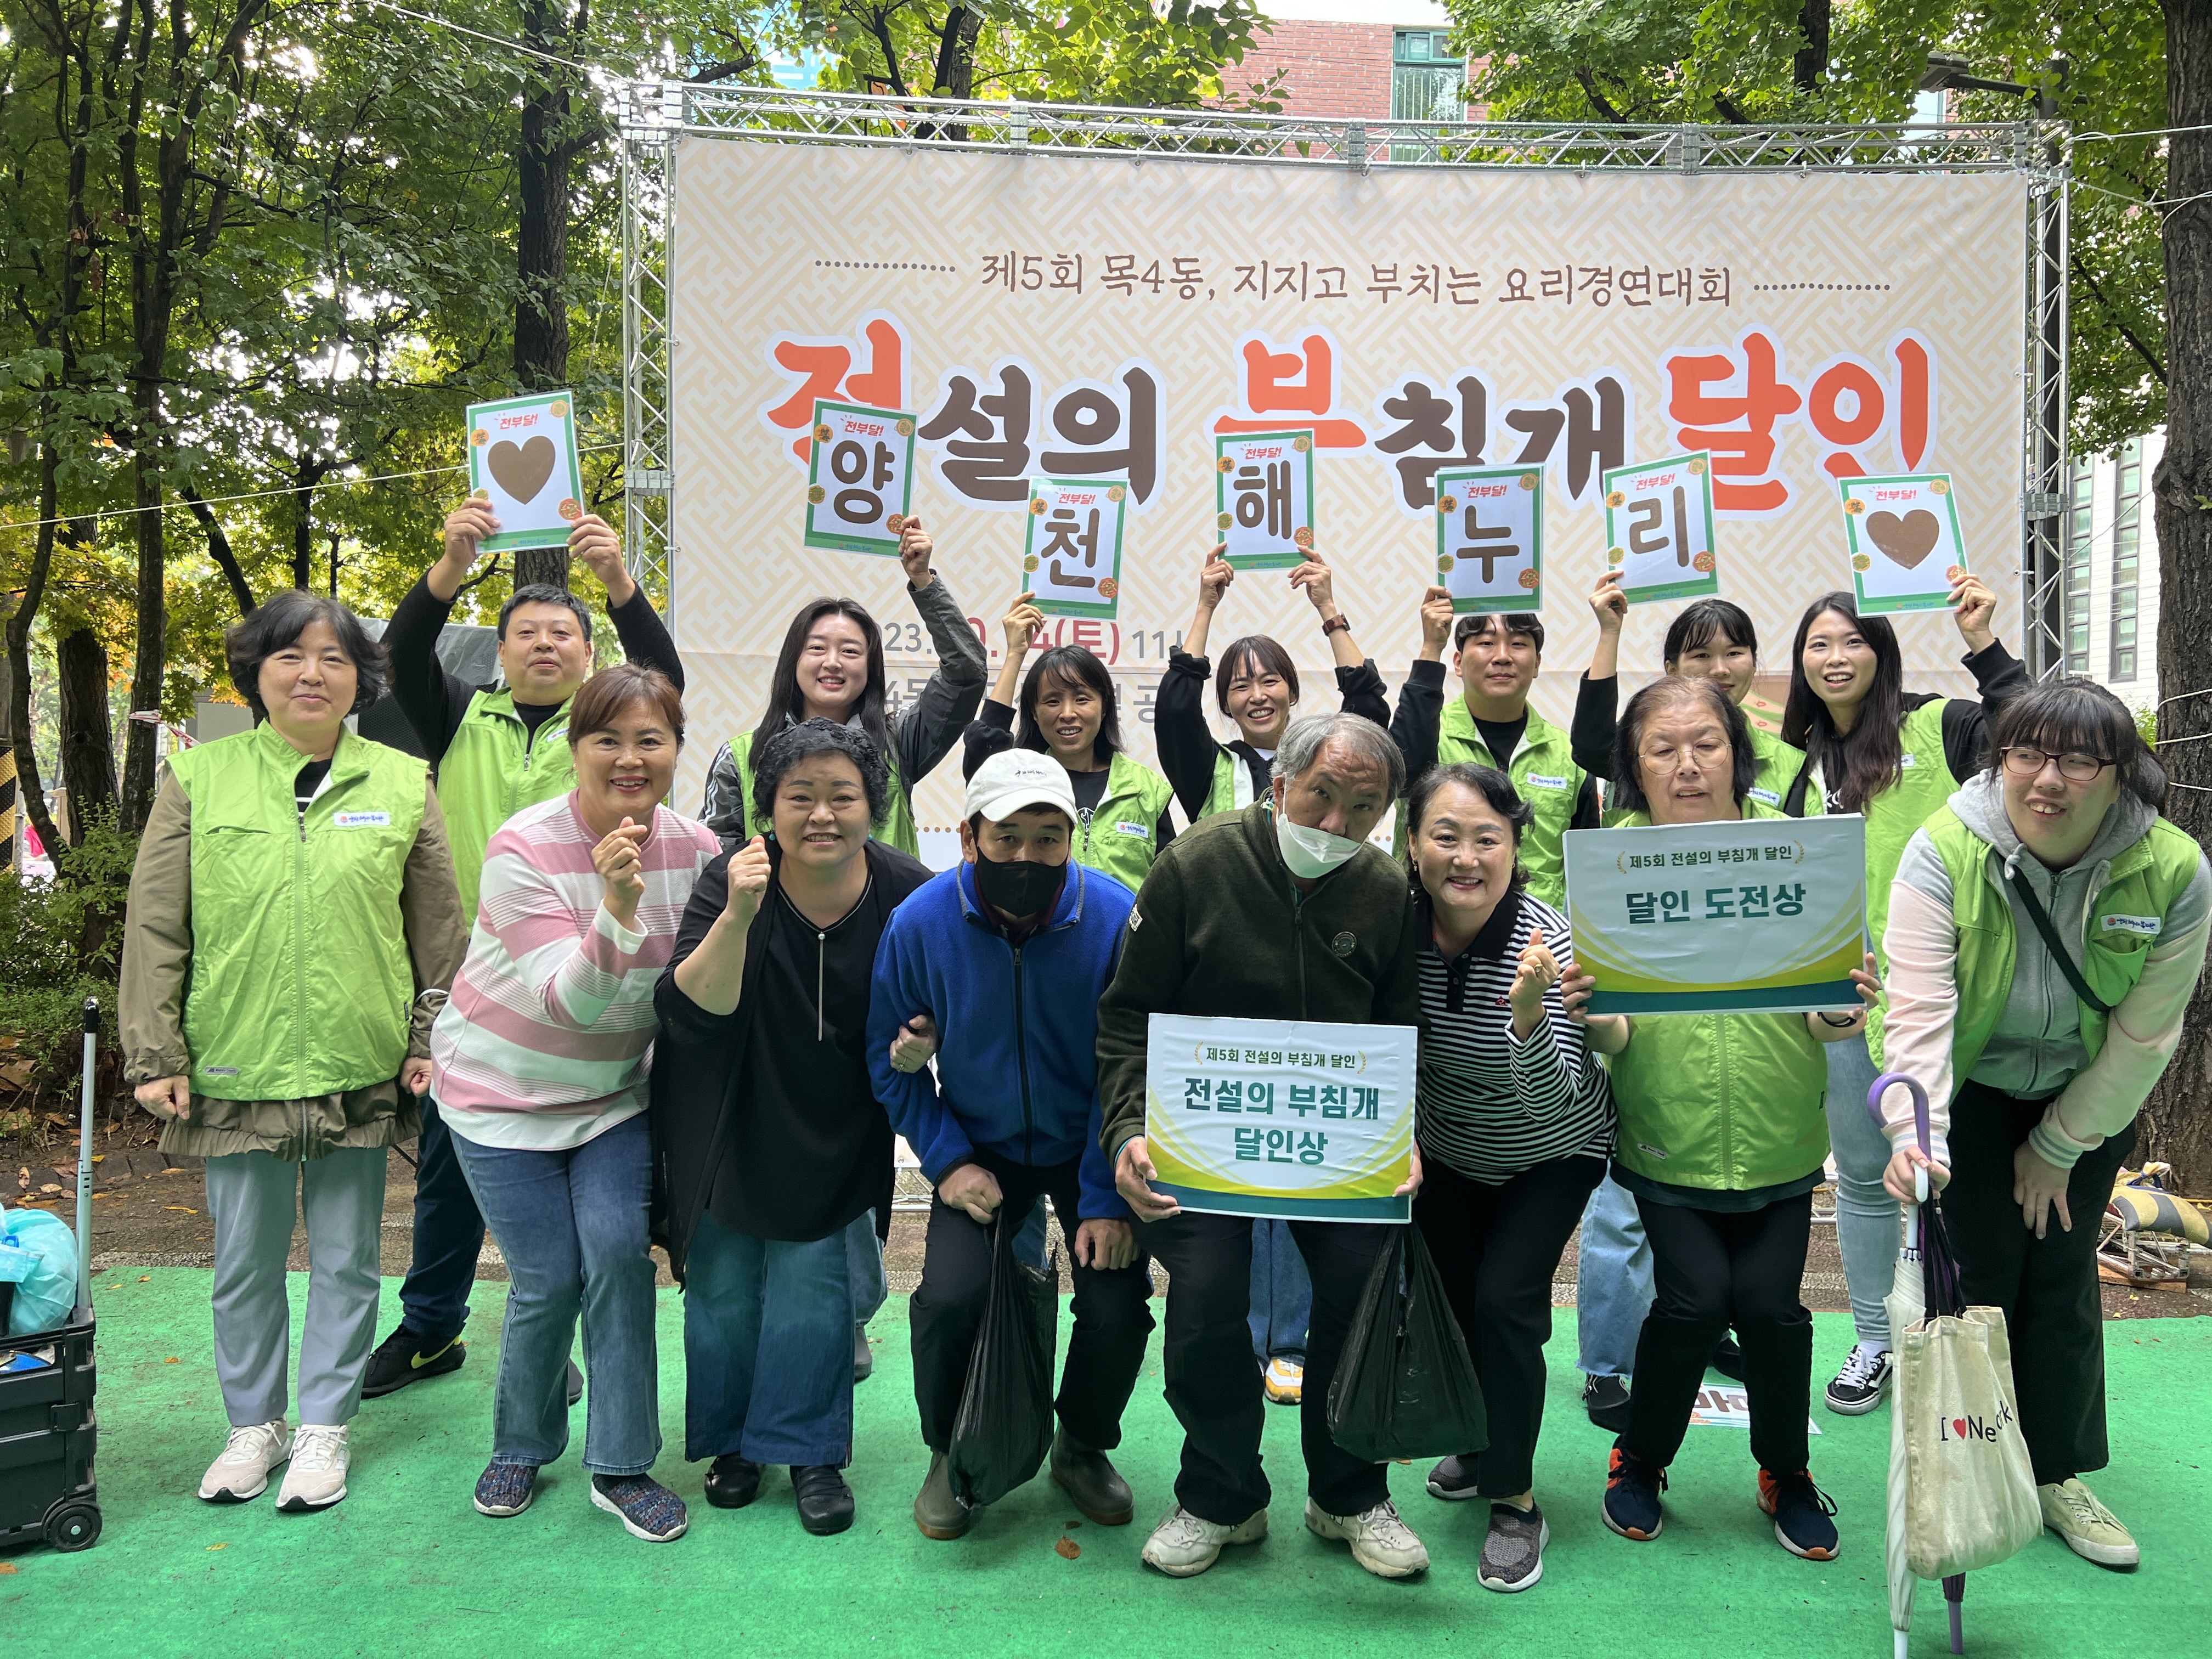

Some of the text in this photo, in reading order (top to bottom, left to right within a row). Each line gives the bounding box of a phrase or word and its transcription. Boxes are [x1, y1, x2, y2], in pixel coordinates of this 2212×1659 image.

[982, 250, 1730, 307] 제5회 목4동, 지지고 부치는 요리경연대회
[500, 413, 538, 430] 전부달!
[768, 319, 1928, 511] 전설의 부침개 달인
[844, 421, 884, 437] 전부달!
[1245, 447, 1282, 460] 전부달!
[831, 440, 895, 524] 양
[1058, 493, 1096, 505] 전부달!
[1233, 460, 1292, 540] 해
[1468, 485, 1508, 499] 전부달!
[1636, 473, 1675, 491] 전부달!
[1875, 489, 1917, 501] 전부달!
[1456, 505, 1520, 584] 누
[1628, 486, 1690, 567] 리
[1041, 508, 1101, 588] 천
[879, 622, 932, 654] 23.
[1132, 630, 1183, 659] 11
[1629, 845, 1792, 868] 제5회 전설의 부침개 달인
[1626, 883, 1807, 924] 달인 도전상
[1206, 1047, 1355, 1069] 제5회 전설의 부침개 달인
[1184, 1077, 1379, 1120] 전설의 부침개
[1234, 1127, 1328, 1165] 달인상
[1967, 1414, 1996, 1442] Ne
